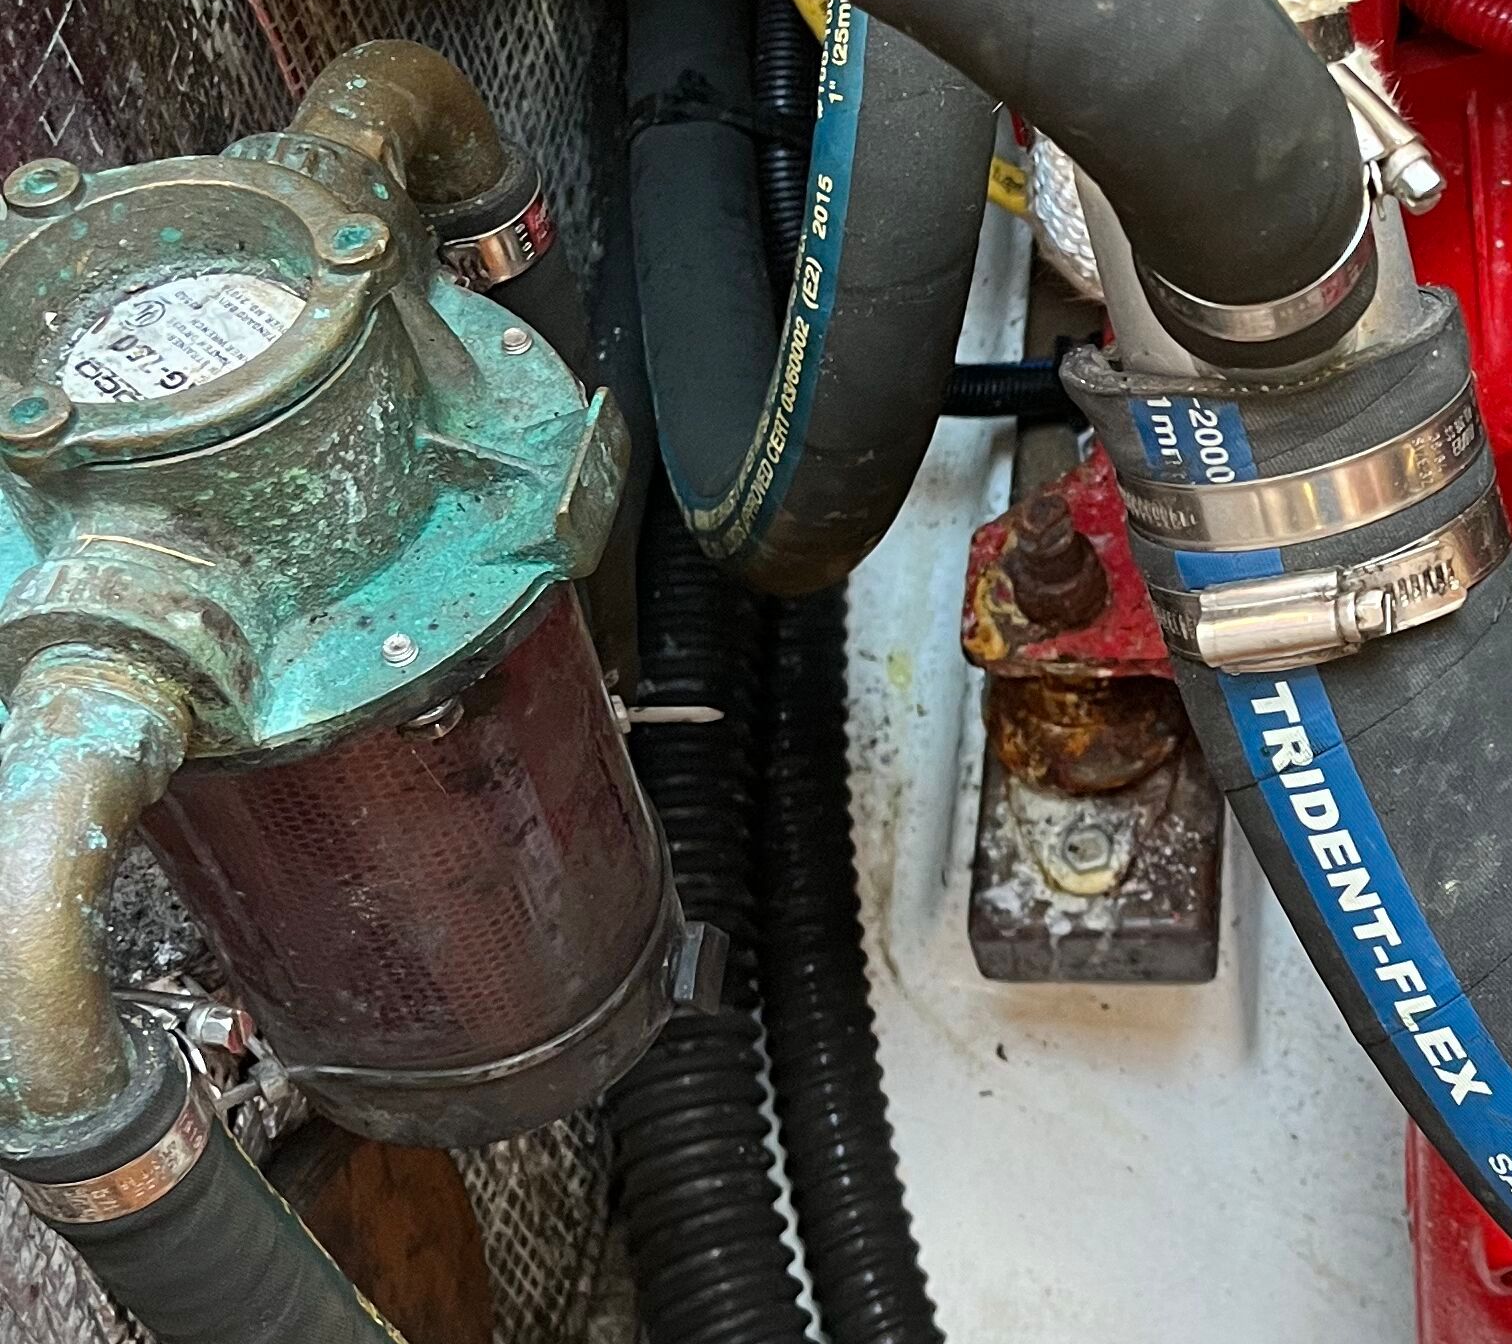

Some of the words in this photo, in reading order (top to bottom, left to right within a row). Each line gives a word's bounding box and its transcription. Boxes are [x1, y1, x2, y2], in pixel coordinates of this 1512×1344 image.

[812, 173, 833, 240] 2015
[802, 256, 823, 310] (E2)
[1250, 681, 1493, 1106] TRIDENT-FLEX
